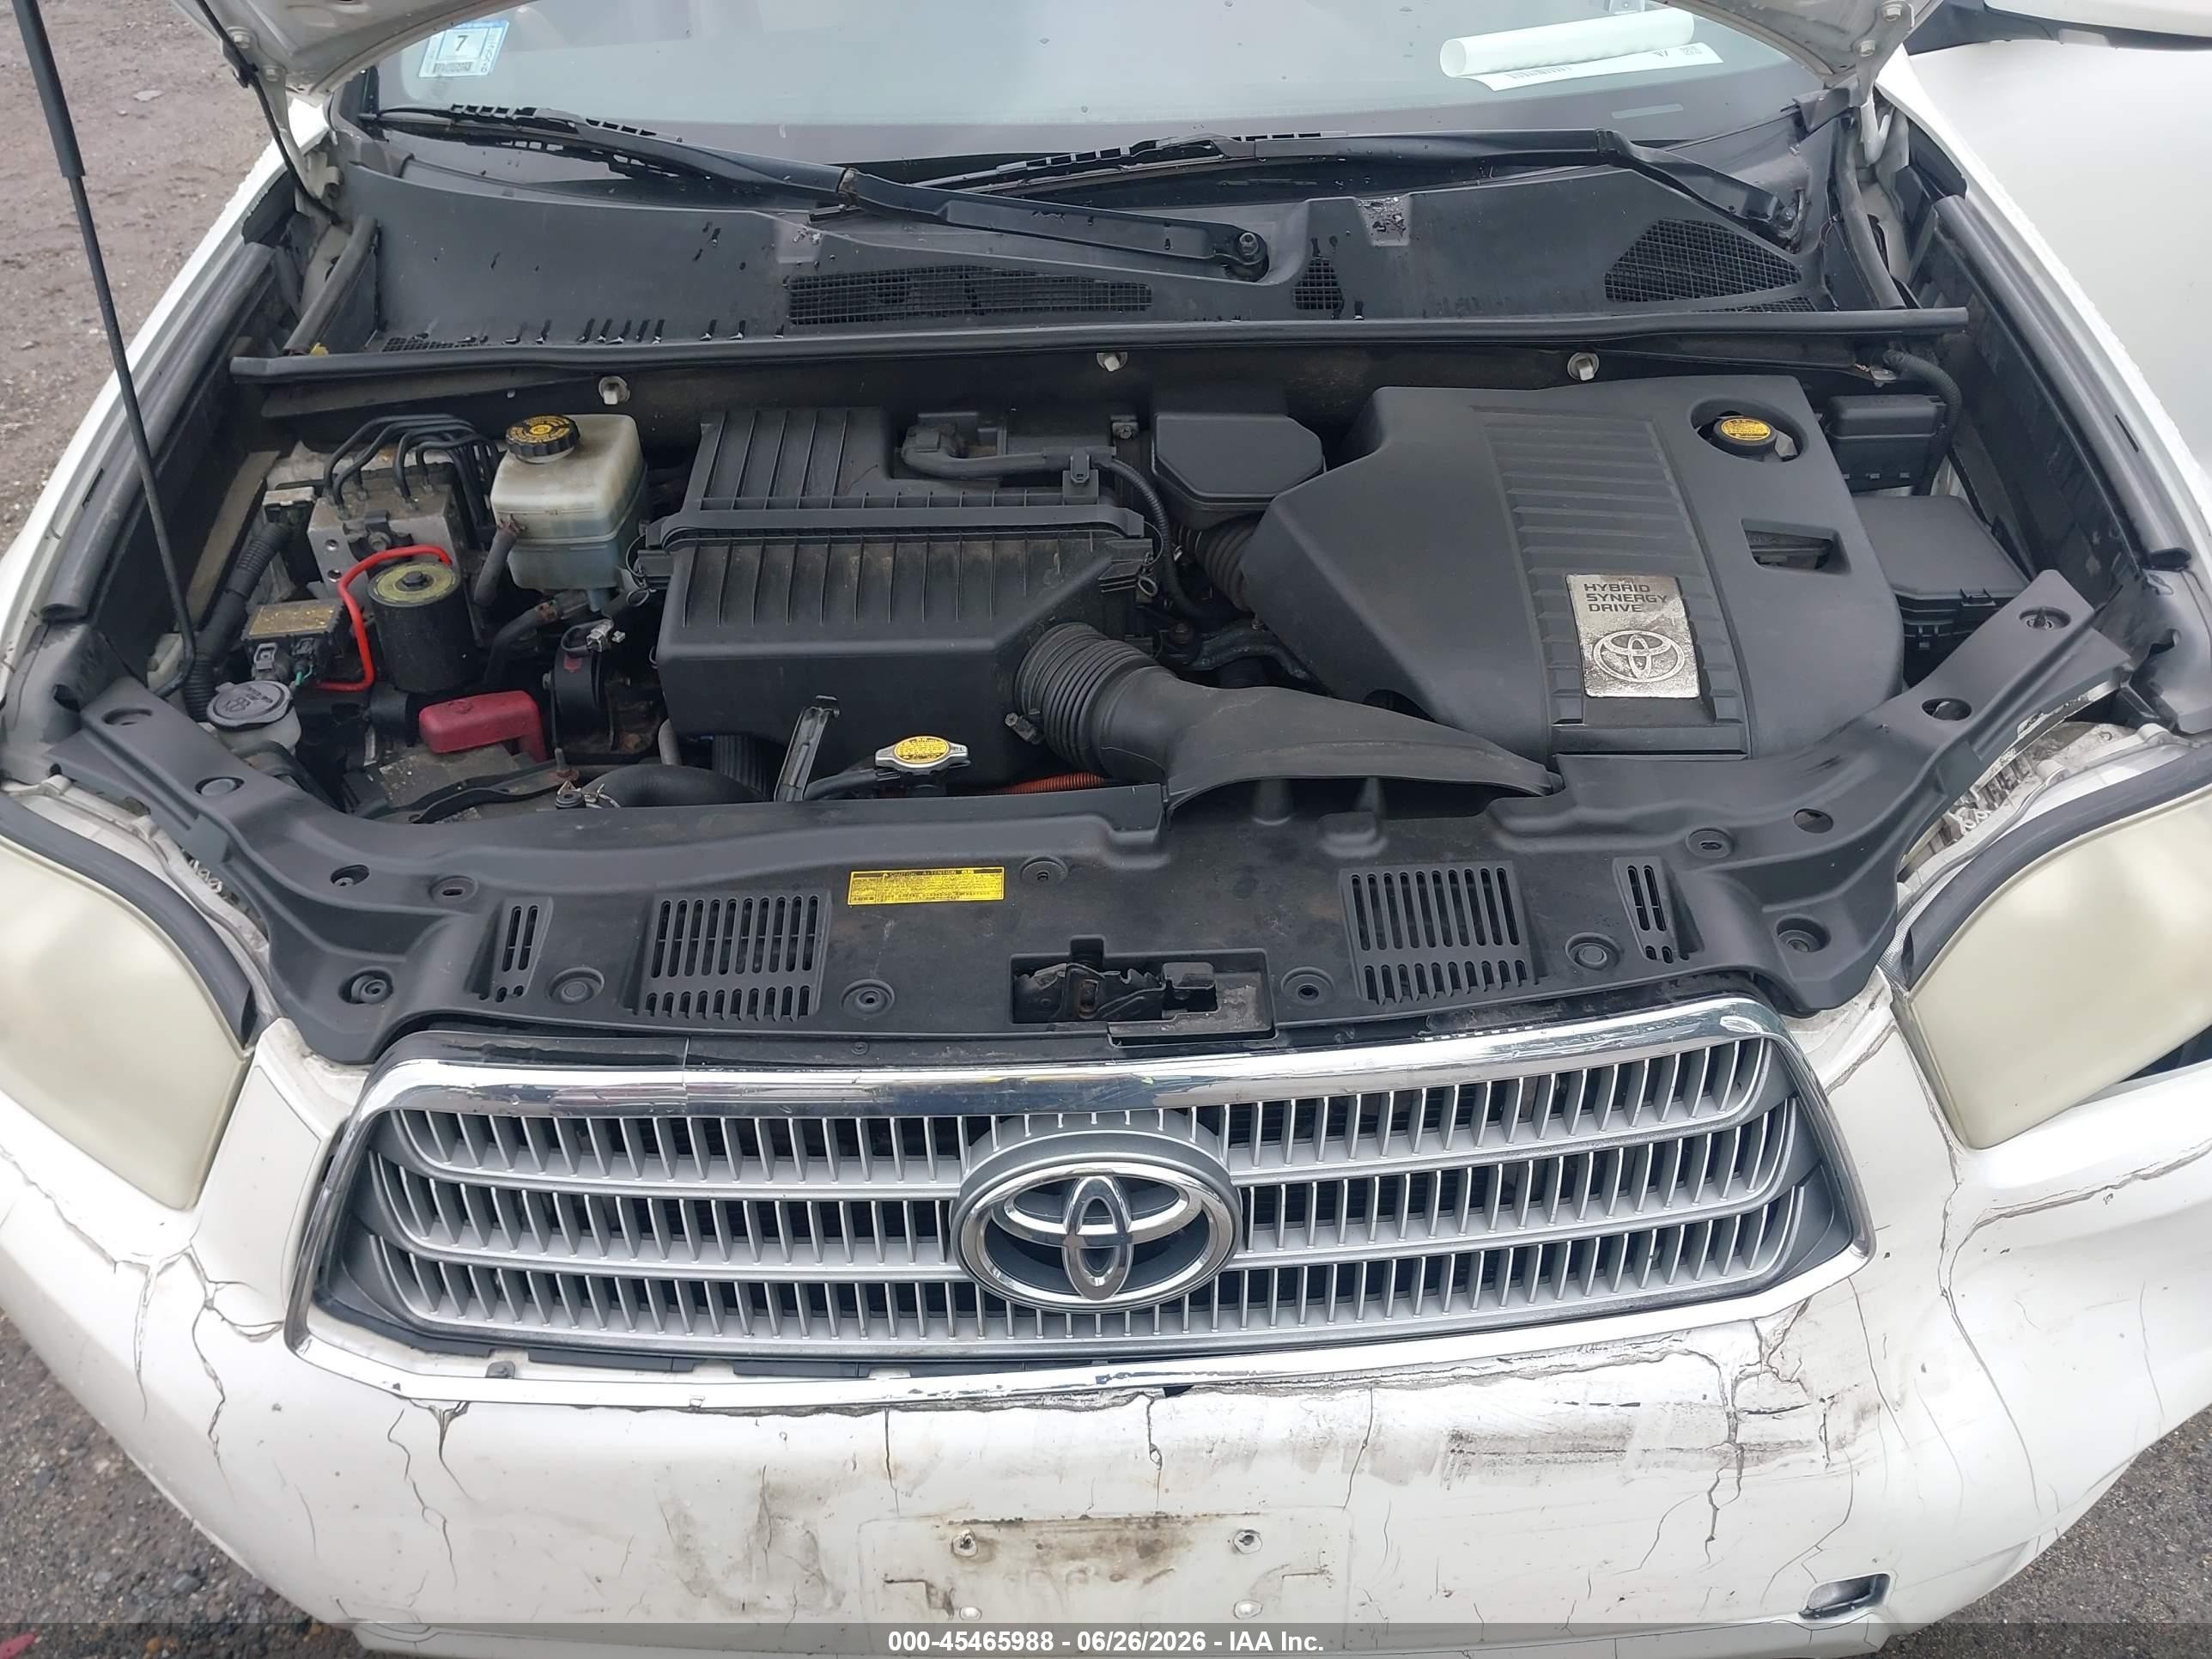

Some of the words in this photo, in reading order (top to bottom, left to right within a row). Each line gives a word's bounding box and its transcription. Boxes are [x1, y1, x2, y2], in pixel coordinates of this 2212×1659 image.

[455, 34, 468, 52] 7
[1583, 583, 1650, 592] HYBRID
[1586, 593, 1668, 603] SYNERGY
[1589, 603, 1643, 612] DRIVE
